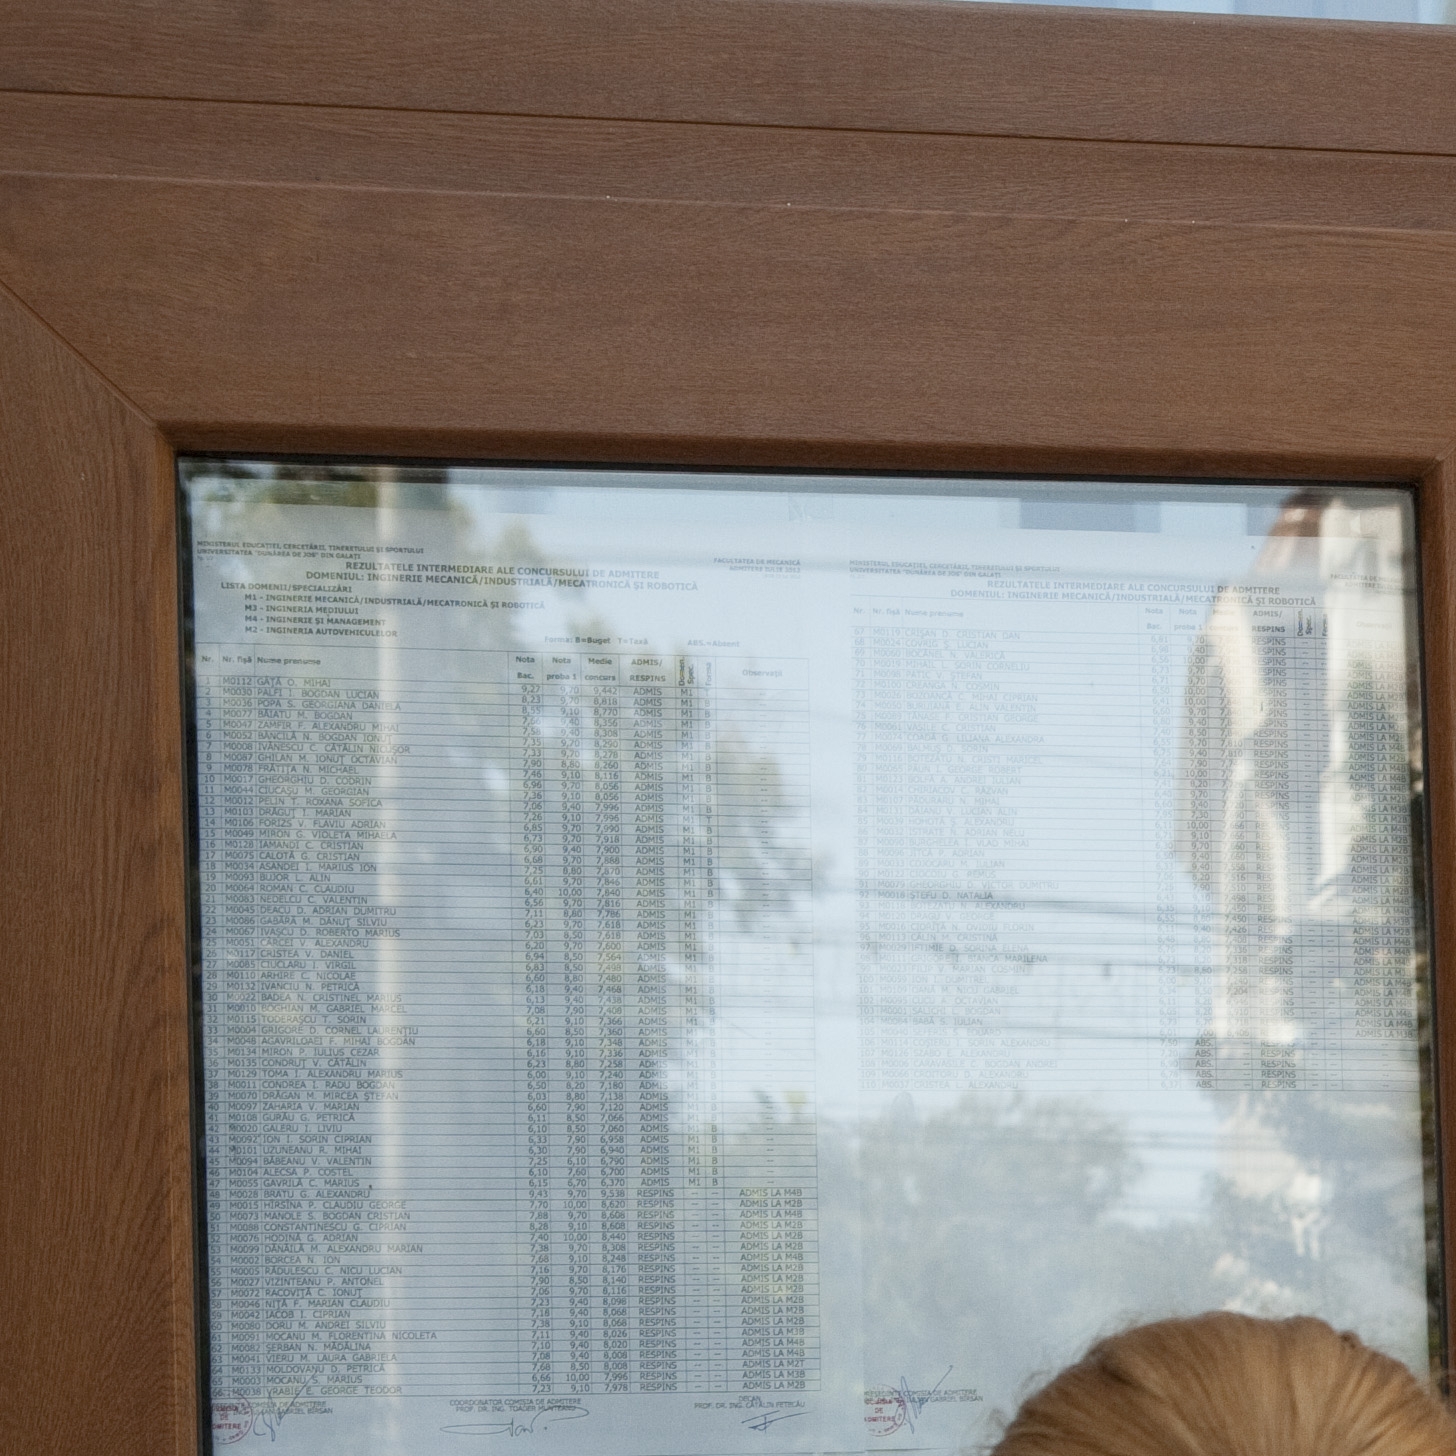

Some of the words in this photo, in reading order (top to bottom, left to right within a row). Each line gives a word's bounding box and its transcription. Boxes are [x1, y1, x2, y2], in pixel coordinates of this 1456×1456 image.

[345, 562, 414, 572] REZULTATELE
[416, 564, 493, 574] INTERMEDIARE
[496, 566, 515, 574] ALE
[517, 566, 589, 576] CONCURSULUI
[592, 568, 605, 577] DE
[608, 568, 659, 578] ADMITERE
[220, 582, 246, 590] LISTA
[248, 581, 352, 593] DOMENII/SPECIALIZĂRI
[305, 571, 364, 581] DOMENIUL:
[367, 573, 422, 583] INGINERIE
[646, 579, 698, 591] ROBOTICĂ
[244, 593, 257, 601] M1
[265, 594, 312, 603] INGINERIE
[501, 599, 544, 609] ROBOTICĂ
